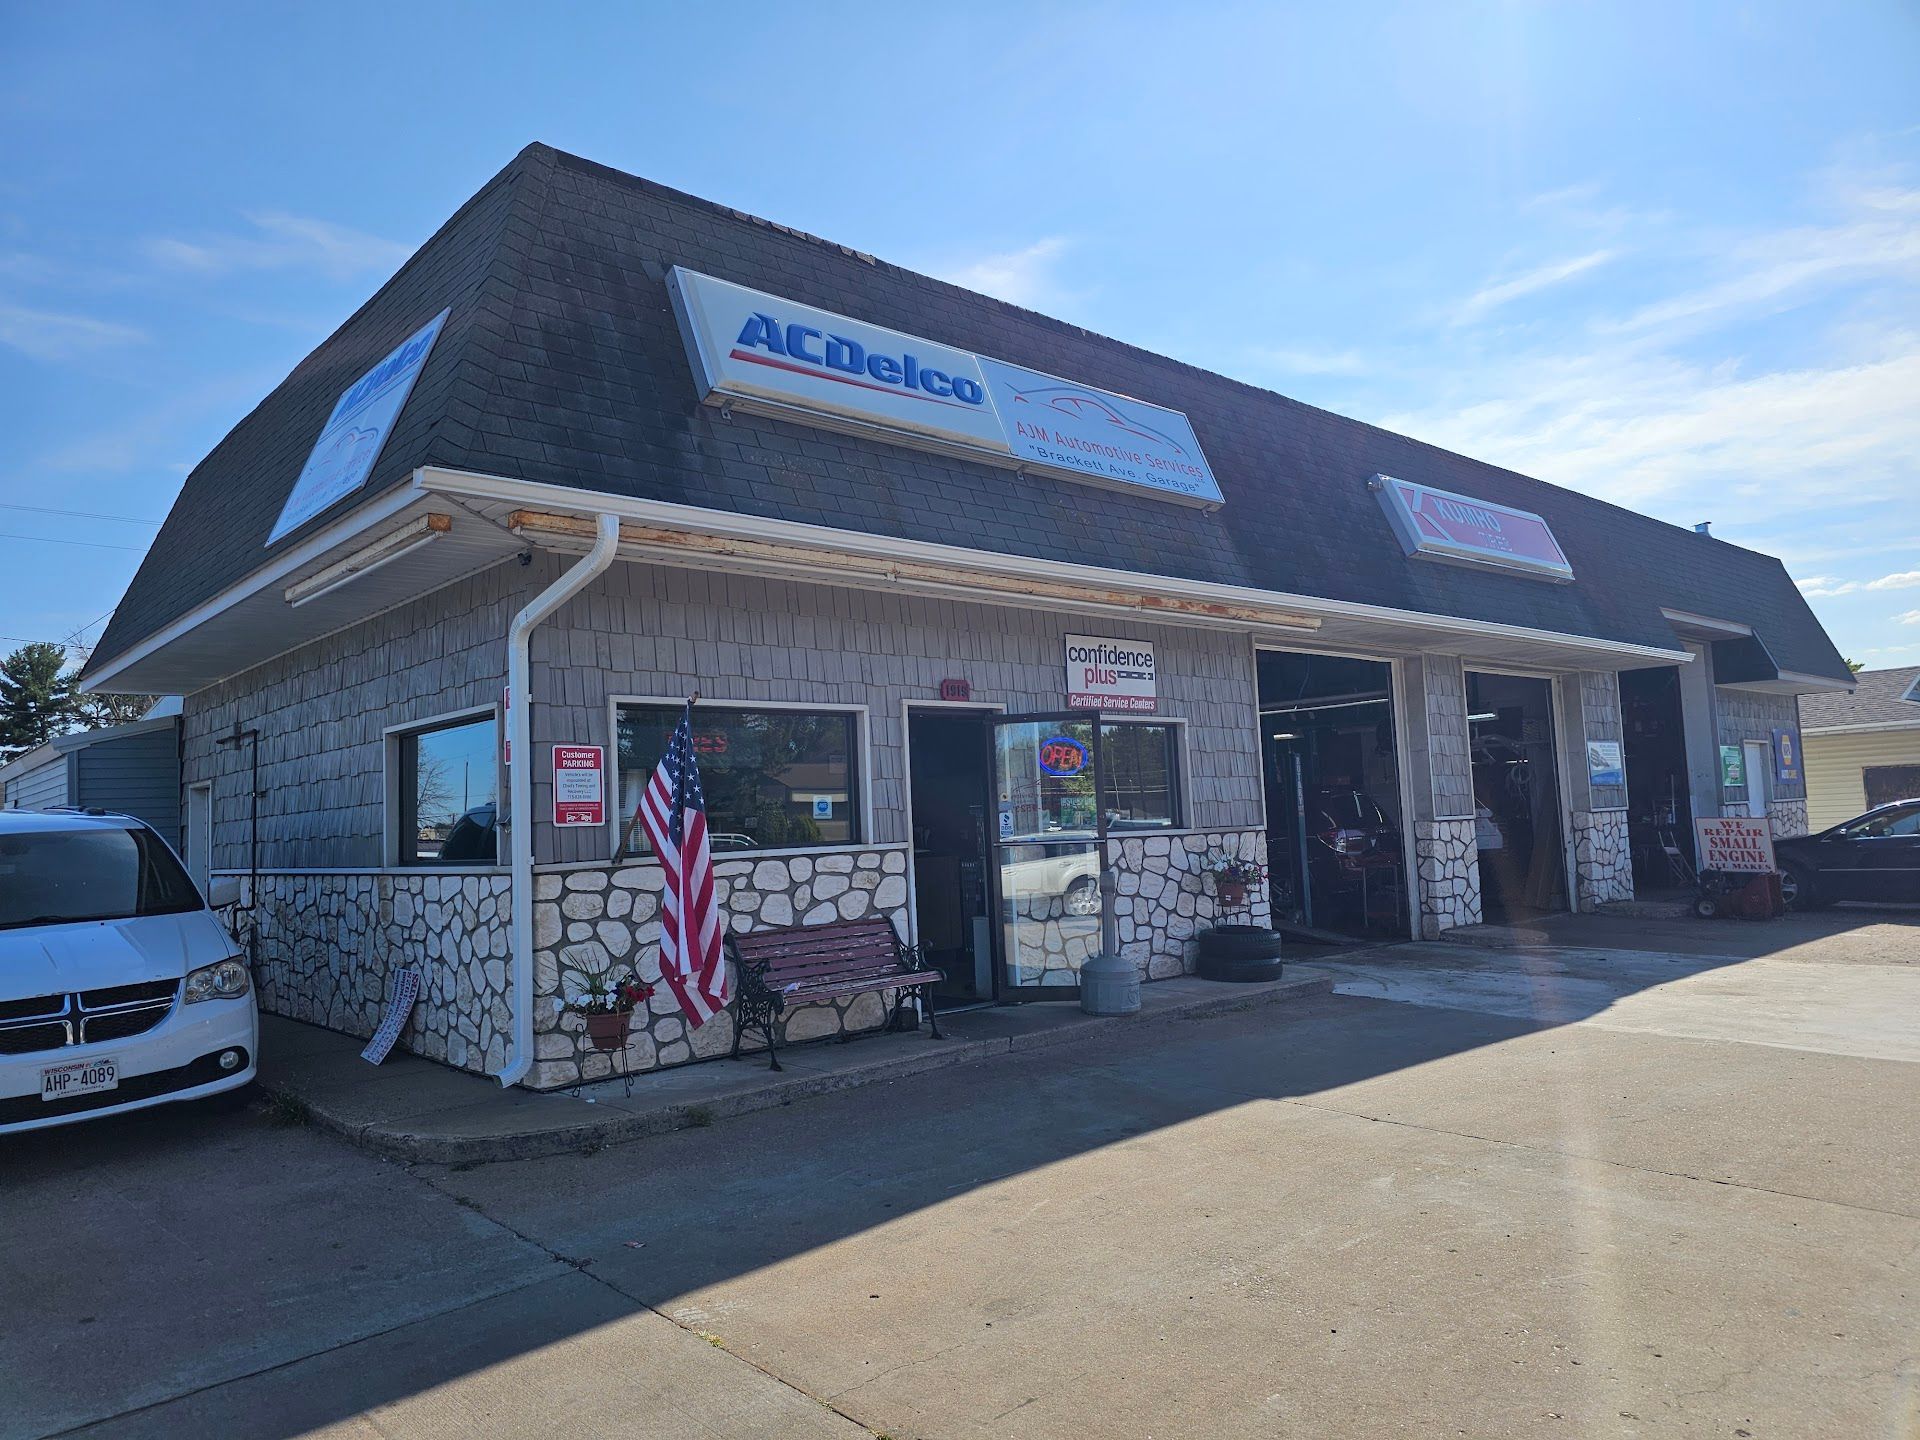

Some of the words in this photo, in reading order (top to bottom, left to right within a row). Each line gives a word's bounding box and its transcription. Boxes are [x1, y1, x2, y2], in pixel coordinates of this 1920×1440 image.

[736, 311, 985, 405] ACDelco
[1016, 420, 1050, 443] AJM
[1055, 431, 1141, 465] Automotive
[1144, 453, 1204, 478] Services
[1028, 445, 1104, 471] "Brackett
[1109, 464, 1142, 480] Ave.
[1146, 472, 1200, 492] Garage"
[1432, 498, 1502, 532] KUMHO
[1068, 644, 1153, 668] confidence
[1084, 663, 1117, 689] plus
[1071, 694, 1102, 708] Certified
[1103, 696, 1129, 708] Service
[1130, 697, 1155, 709] Centers
[562, 751, 595, 759] Customer
[1041, 745, 1083, 768] OPEN
[1704, 828, 1764, 836] REPAIR
[1720, 821, 1744, 829] WE
[1710, 836, 1760, 849] SMALL
[1708, 850, 1767, 862] ENGINE
[44, 1063, 85, 1075] WISCONSIN
[45, 1066, 115, 1093] AHP-4089
